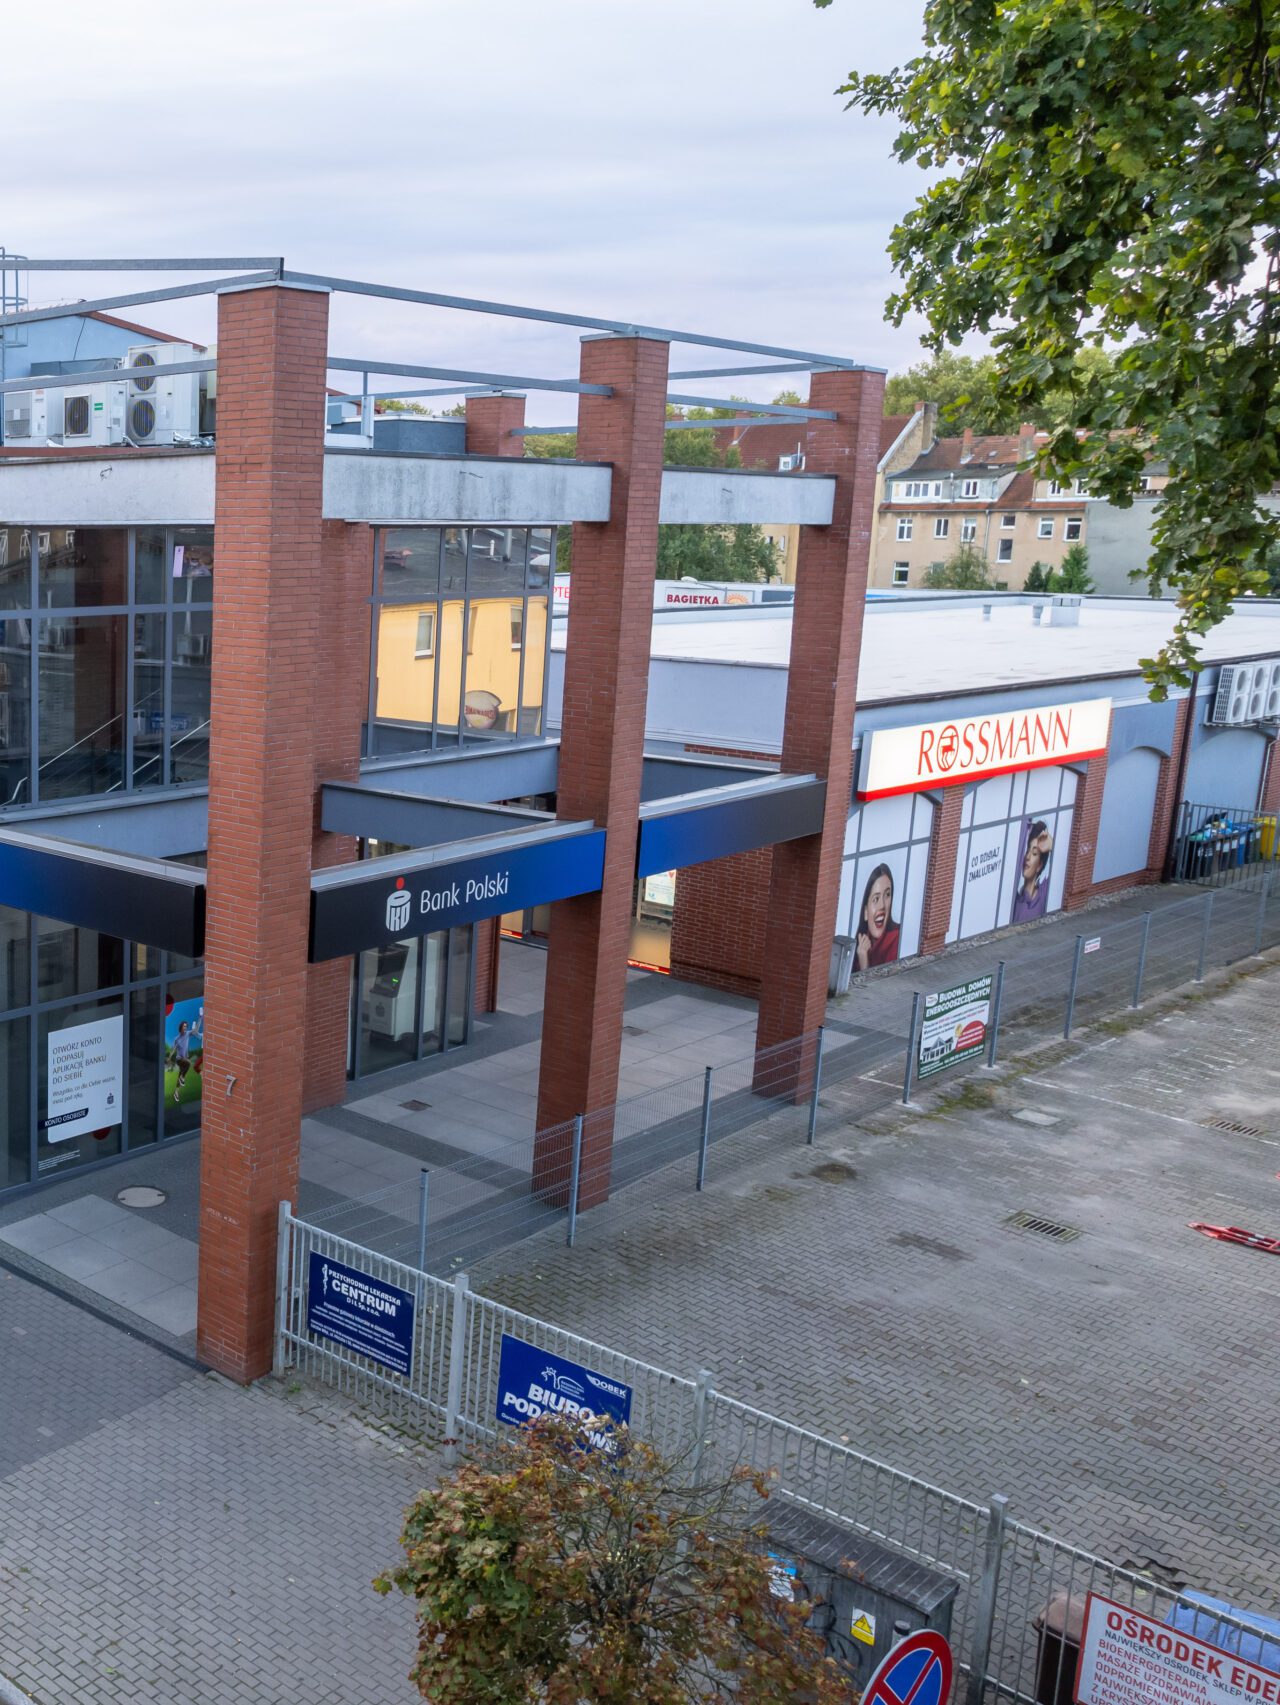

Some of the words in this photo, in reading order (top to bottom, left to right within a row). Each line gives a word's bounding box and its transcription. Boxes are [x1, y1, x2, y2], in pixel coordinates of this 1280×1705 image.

[666, 593, 719, 605] BAGIETKA
[917, 708, 1072, 776] ROSSMANN
[971, 856, 979, 868] CO
[420, 882, 460, 914] Bank
[465, 871, 509, 903] Polski
[939, 986, 966, 1004] BUDOWA
[968, 977, 992, 992] DOMÓW
[52, 1042, 79, 1055] OTWÓRZ
[80, 1036, 103, 1048] KONTO
[56, 1050, 84, 1064] DOPASUJ
[85, 1055, 107, 1067] BANKU
[52, 1076, 62, 1085] DO
[63, 1071, 83, 1081] SIEBIE
[225, 1074, 237, 1096] 7
[44, 1116, 63, 1127] KONTO
[62, 1109, 87, 1122] OSOBISTE
[328, 1269, 369, 1292] PRZYCHODNIA
[369, 1287, 401, 1307] LEKARSKA
[331, 1278, 396, 1318] CENTRUM
[592, 1377, 626, 1398] DOBEK
[528, 1383, 596, 1424] BIURO
[1107, 1612, 1224, 1679] OŚRODEK
[1097, 1650, 1141, 1677] MASAŻE
[1099, 1639, 1207, 1696] BIOENERGOTERAPIA
[1105, 1629, 1162, 1661] NAJWIĘKSZY
[1212, 1679, 1242, 1697] SKLEP
[1244, 1693, 1254, 1703] W
[1091, 1683, 1099, 1693] Z
